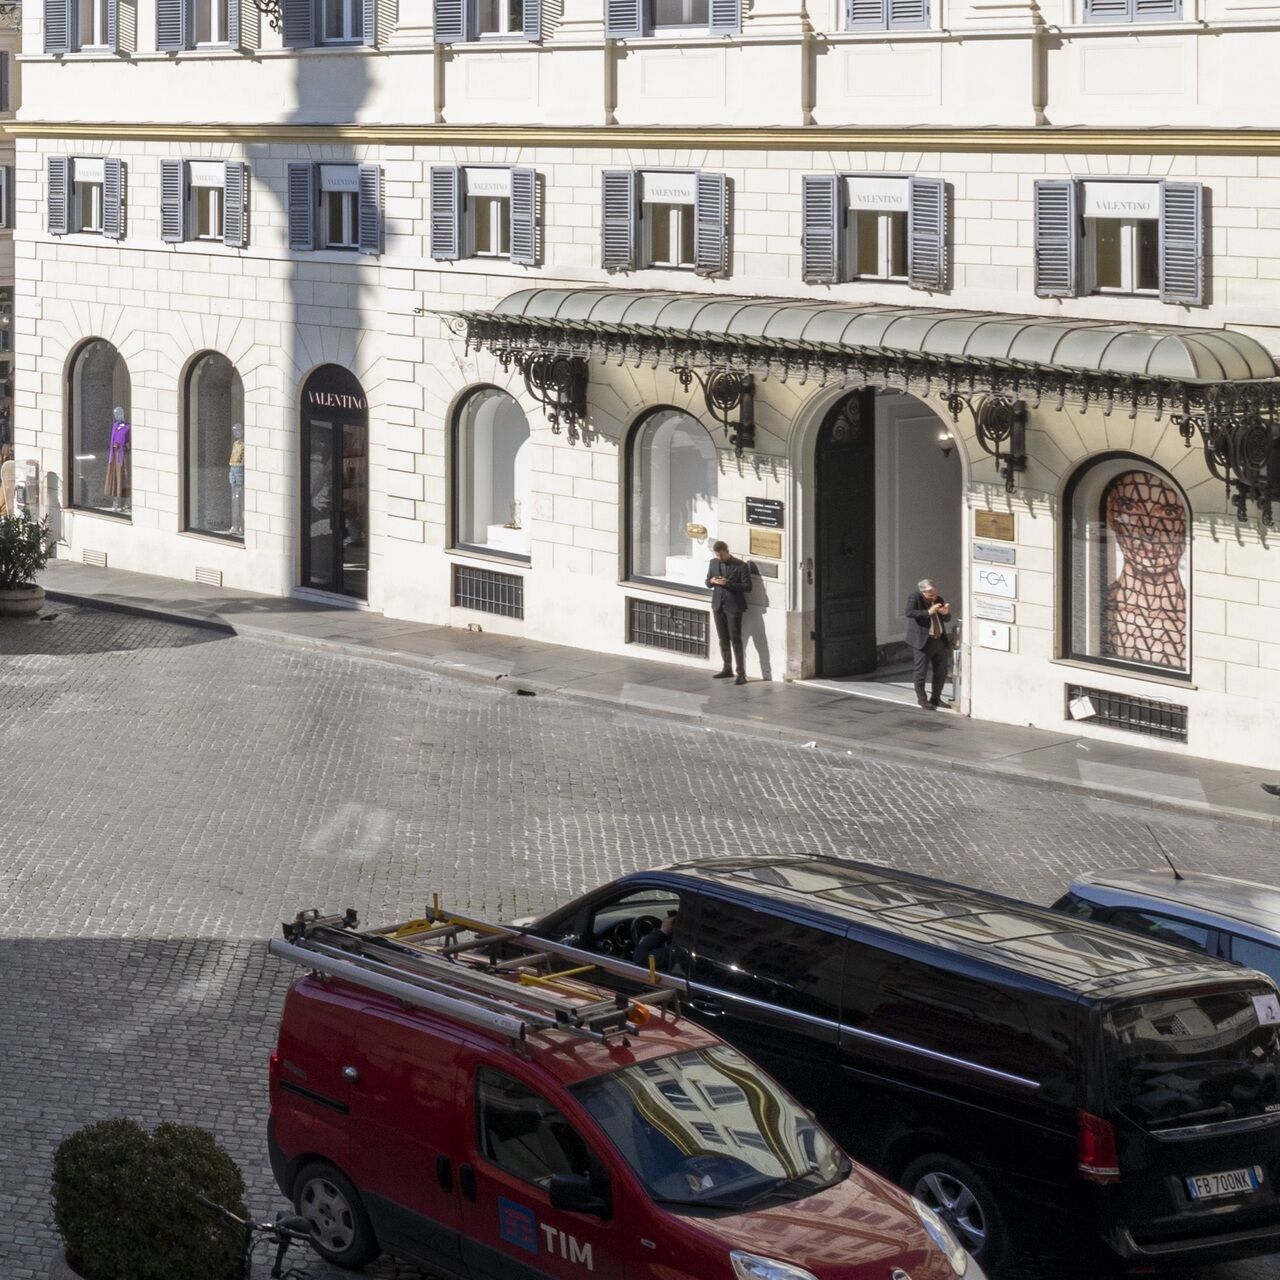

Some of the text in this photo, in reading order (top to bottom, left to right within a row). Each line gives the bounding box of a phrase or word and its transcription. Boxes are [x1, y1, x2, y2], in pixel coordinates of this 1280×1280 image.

[857, 194, 903, 203] VALENTINO
[1096, 200, 1150, 210] VALENTINO
[308, 390, 367, 410] VALENTINO
[979, 570, 1008, 588] FGA
[540, 1222, 593, 1271] TIM
